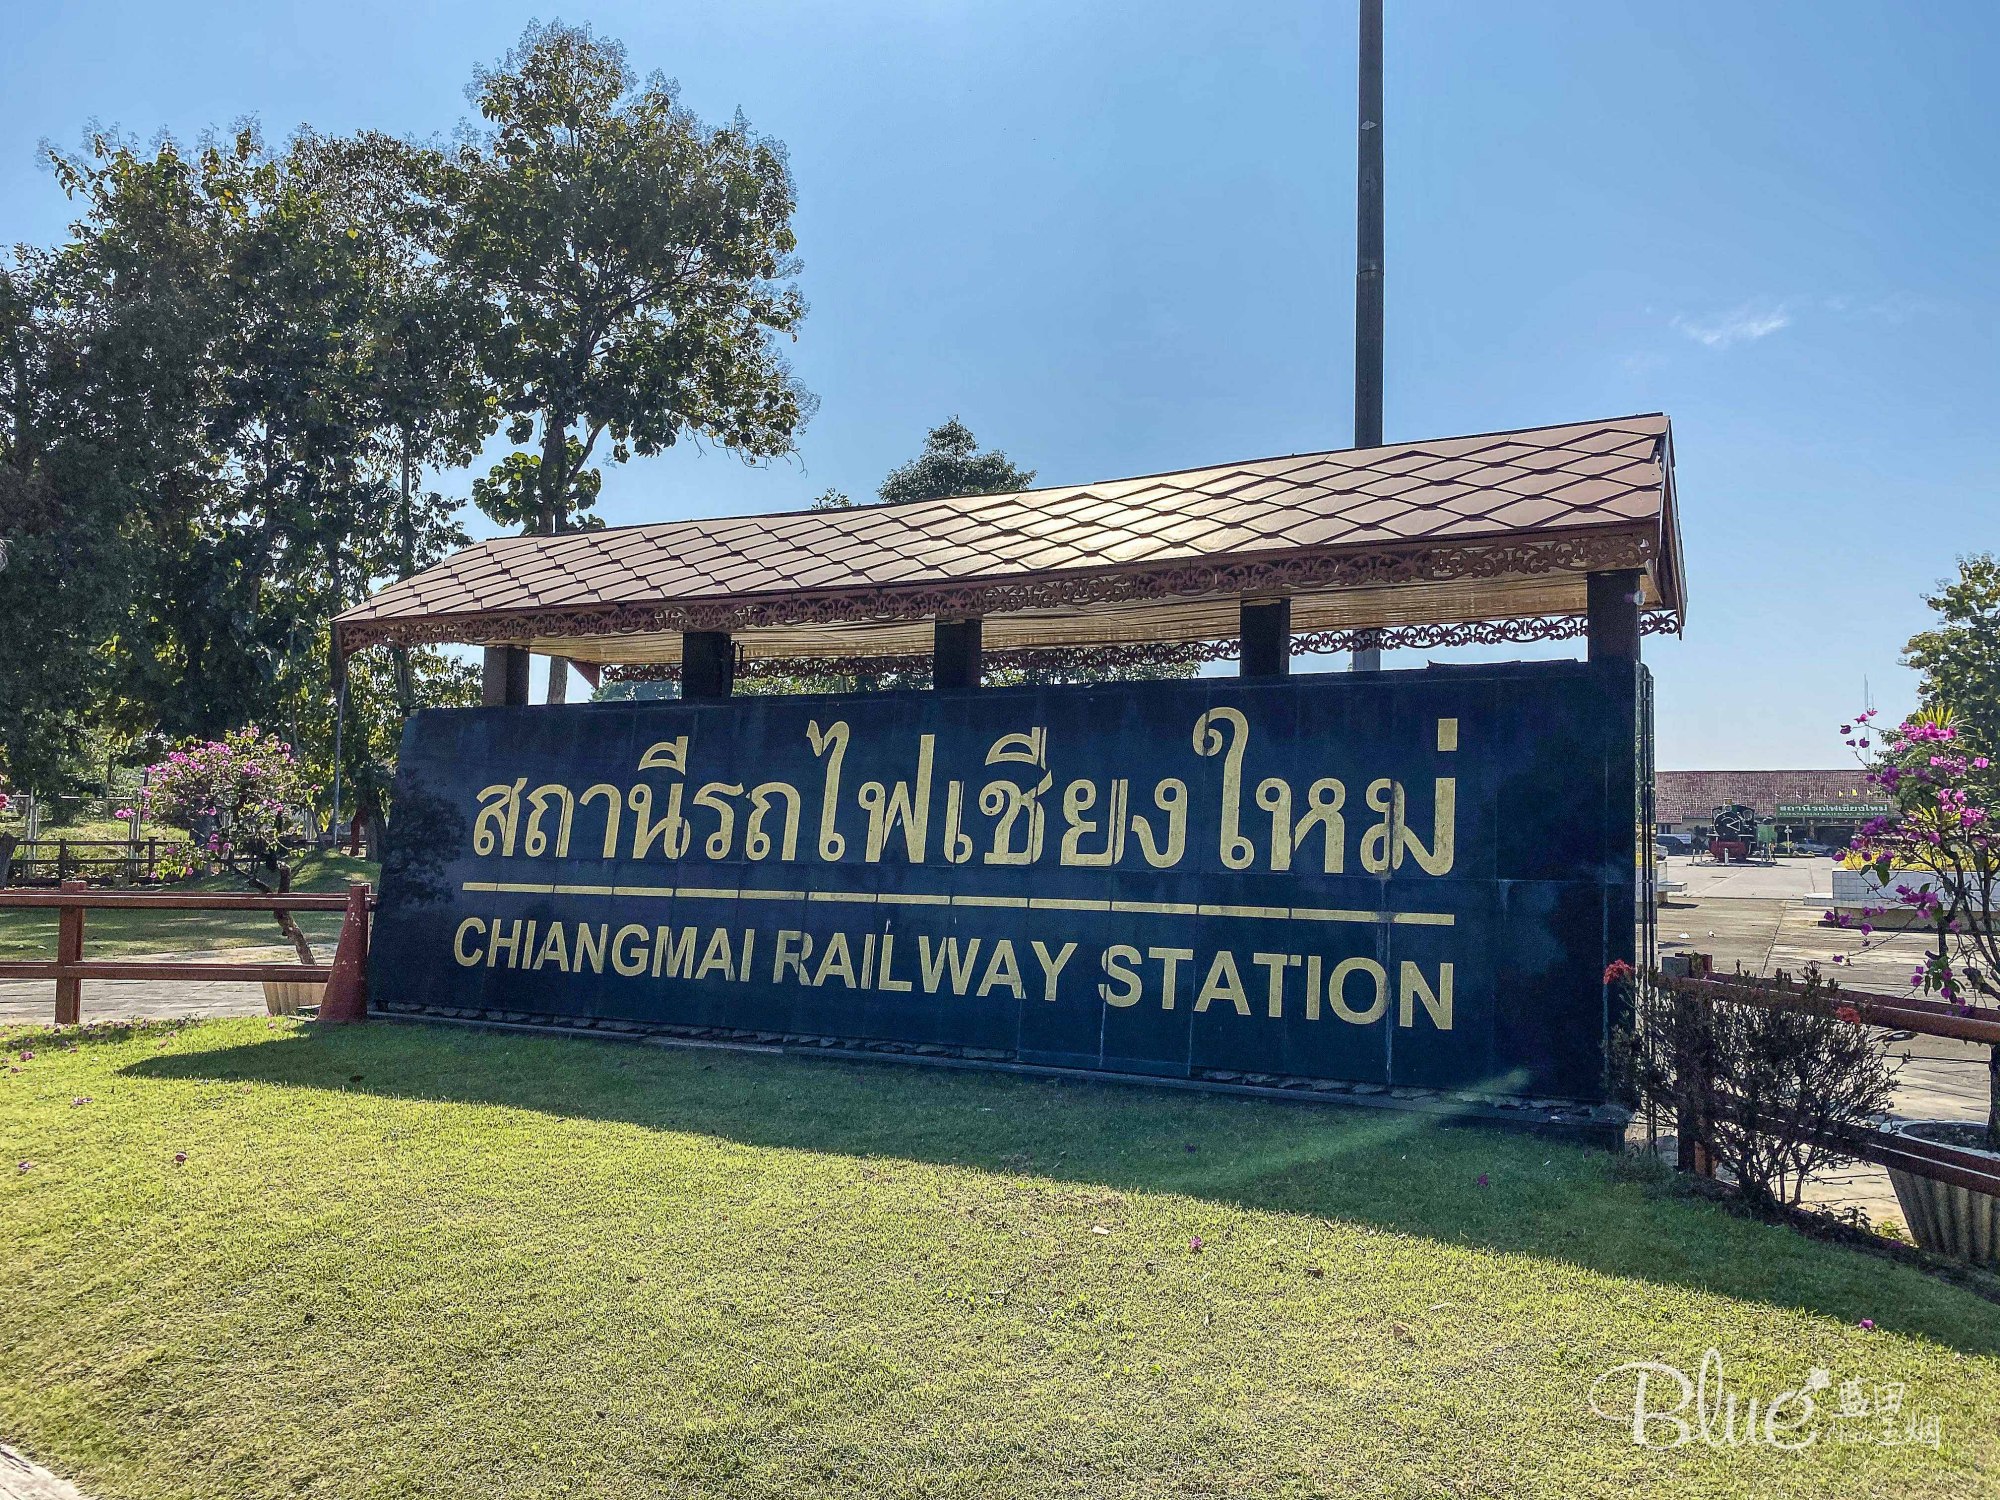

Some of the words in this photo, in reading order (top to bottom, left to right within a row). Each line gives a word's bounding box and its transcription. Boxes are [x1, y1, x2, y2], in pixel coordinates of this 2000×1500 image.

[473, 706, 1457, 877] สถานีรถไฟเชียงใหม่
[453, 916, 756, 983] CHIANGMAI
[773, 930, 1078, 1002] RAILWAY
[1098, 944, 1454, 1031] STATION
